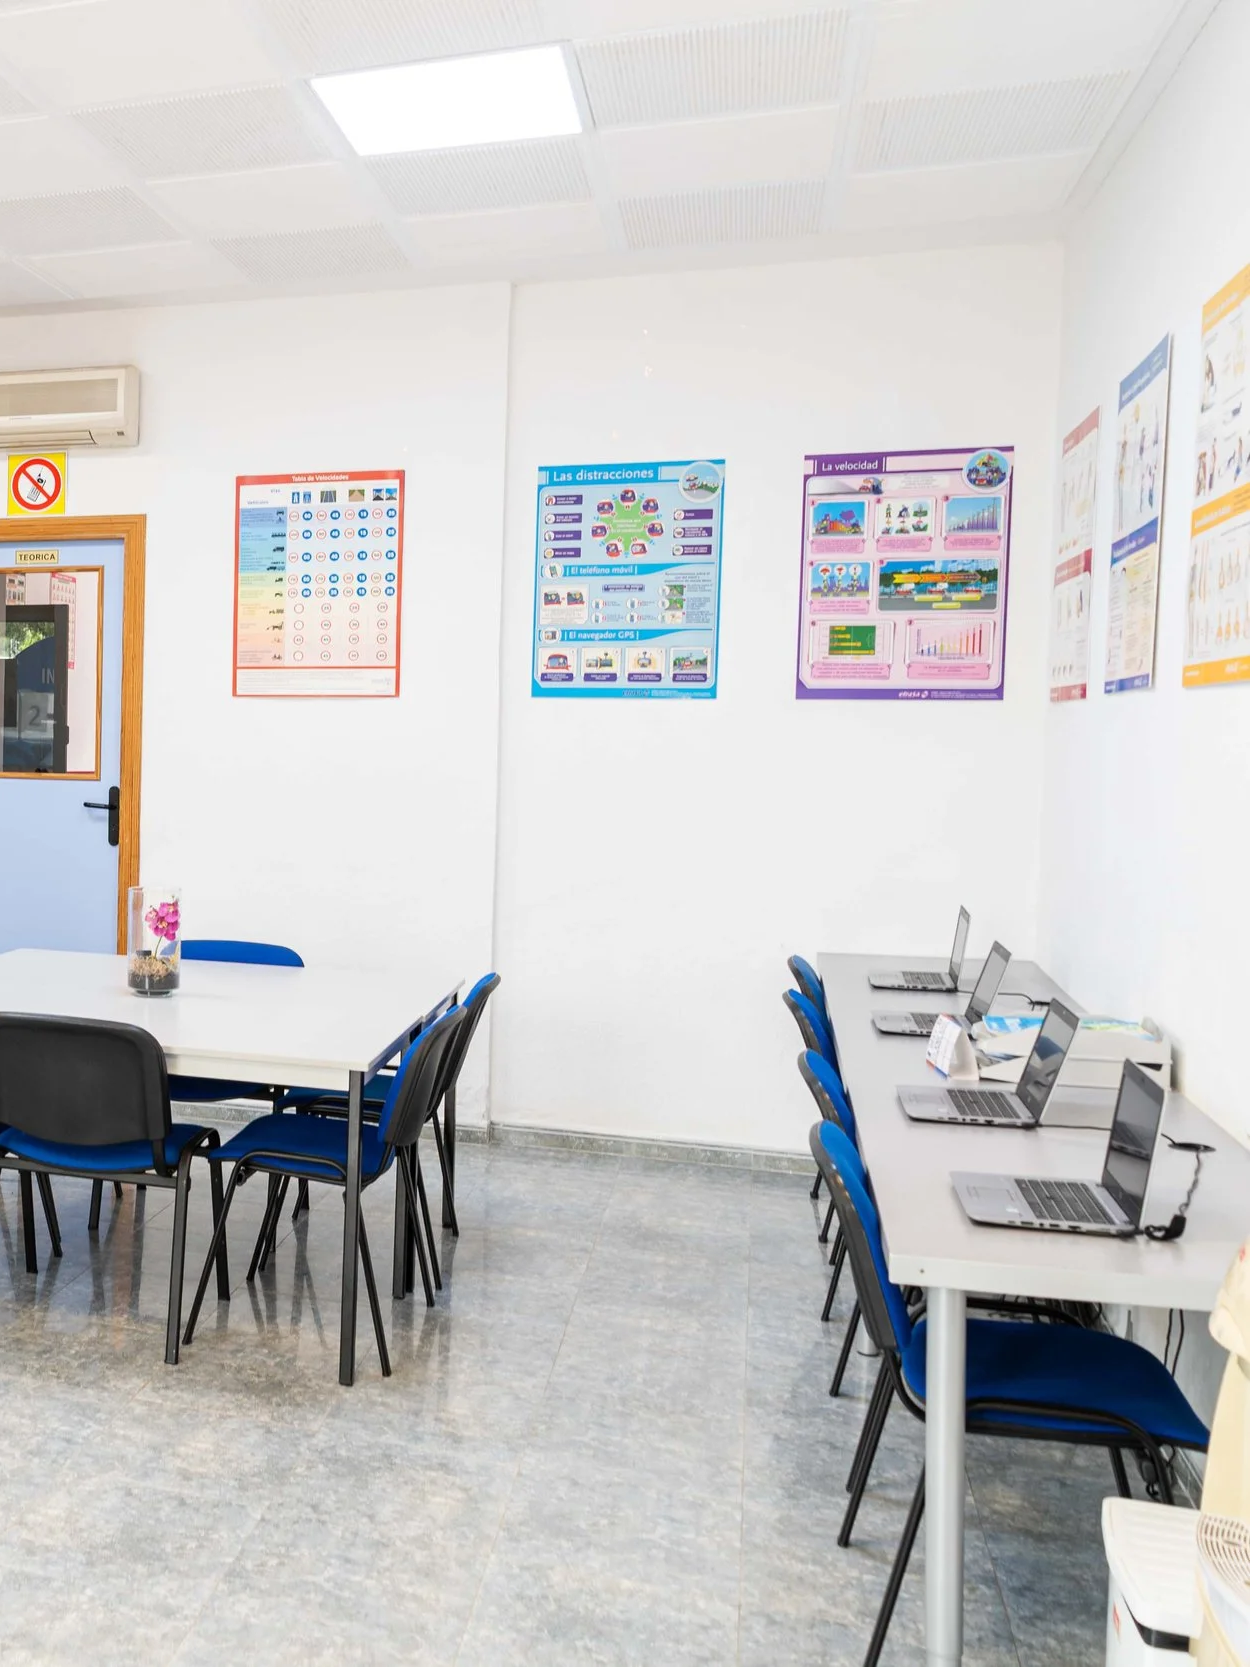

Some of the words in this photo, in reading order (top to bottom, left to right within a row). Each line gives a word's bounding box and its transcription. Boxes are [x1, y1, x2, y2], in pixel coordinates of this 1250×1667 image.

[822, 462, 832, 471] La
[835, 459, 878, 471] velocidad
[553, 471, 573, 482] Las
[576, 468, 654, 481] distracciones
[19, 553, 56, 561] TEORICA
[571, 566, 578, 574] El
[579, 565, 610, 574] teléfono
[612, 565, 633, 574] móvil
[569, 631, 576, 639] El
[578, 630, 616, 641] navegador
[618, 631, 635, 639] GPS
